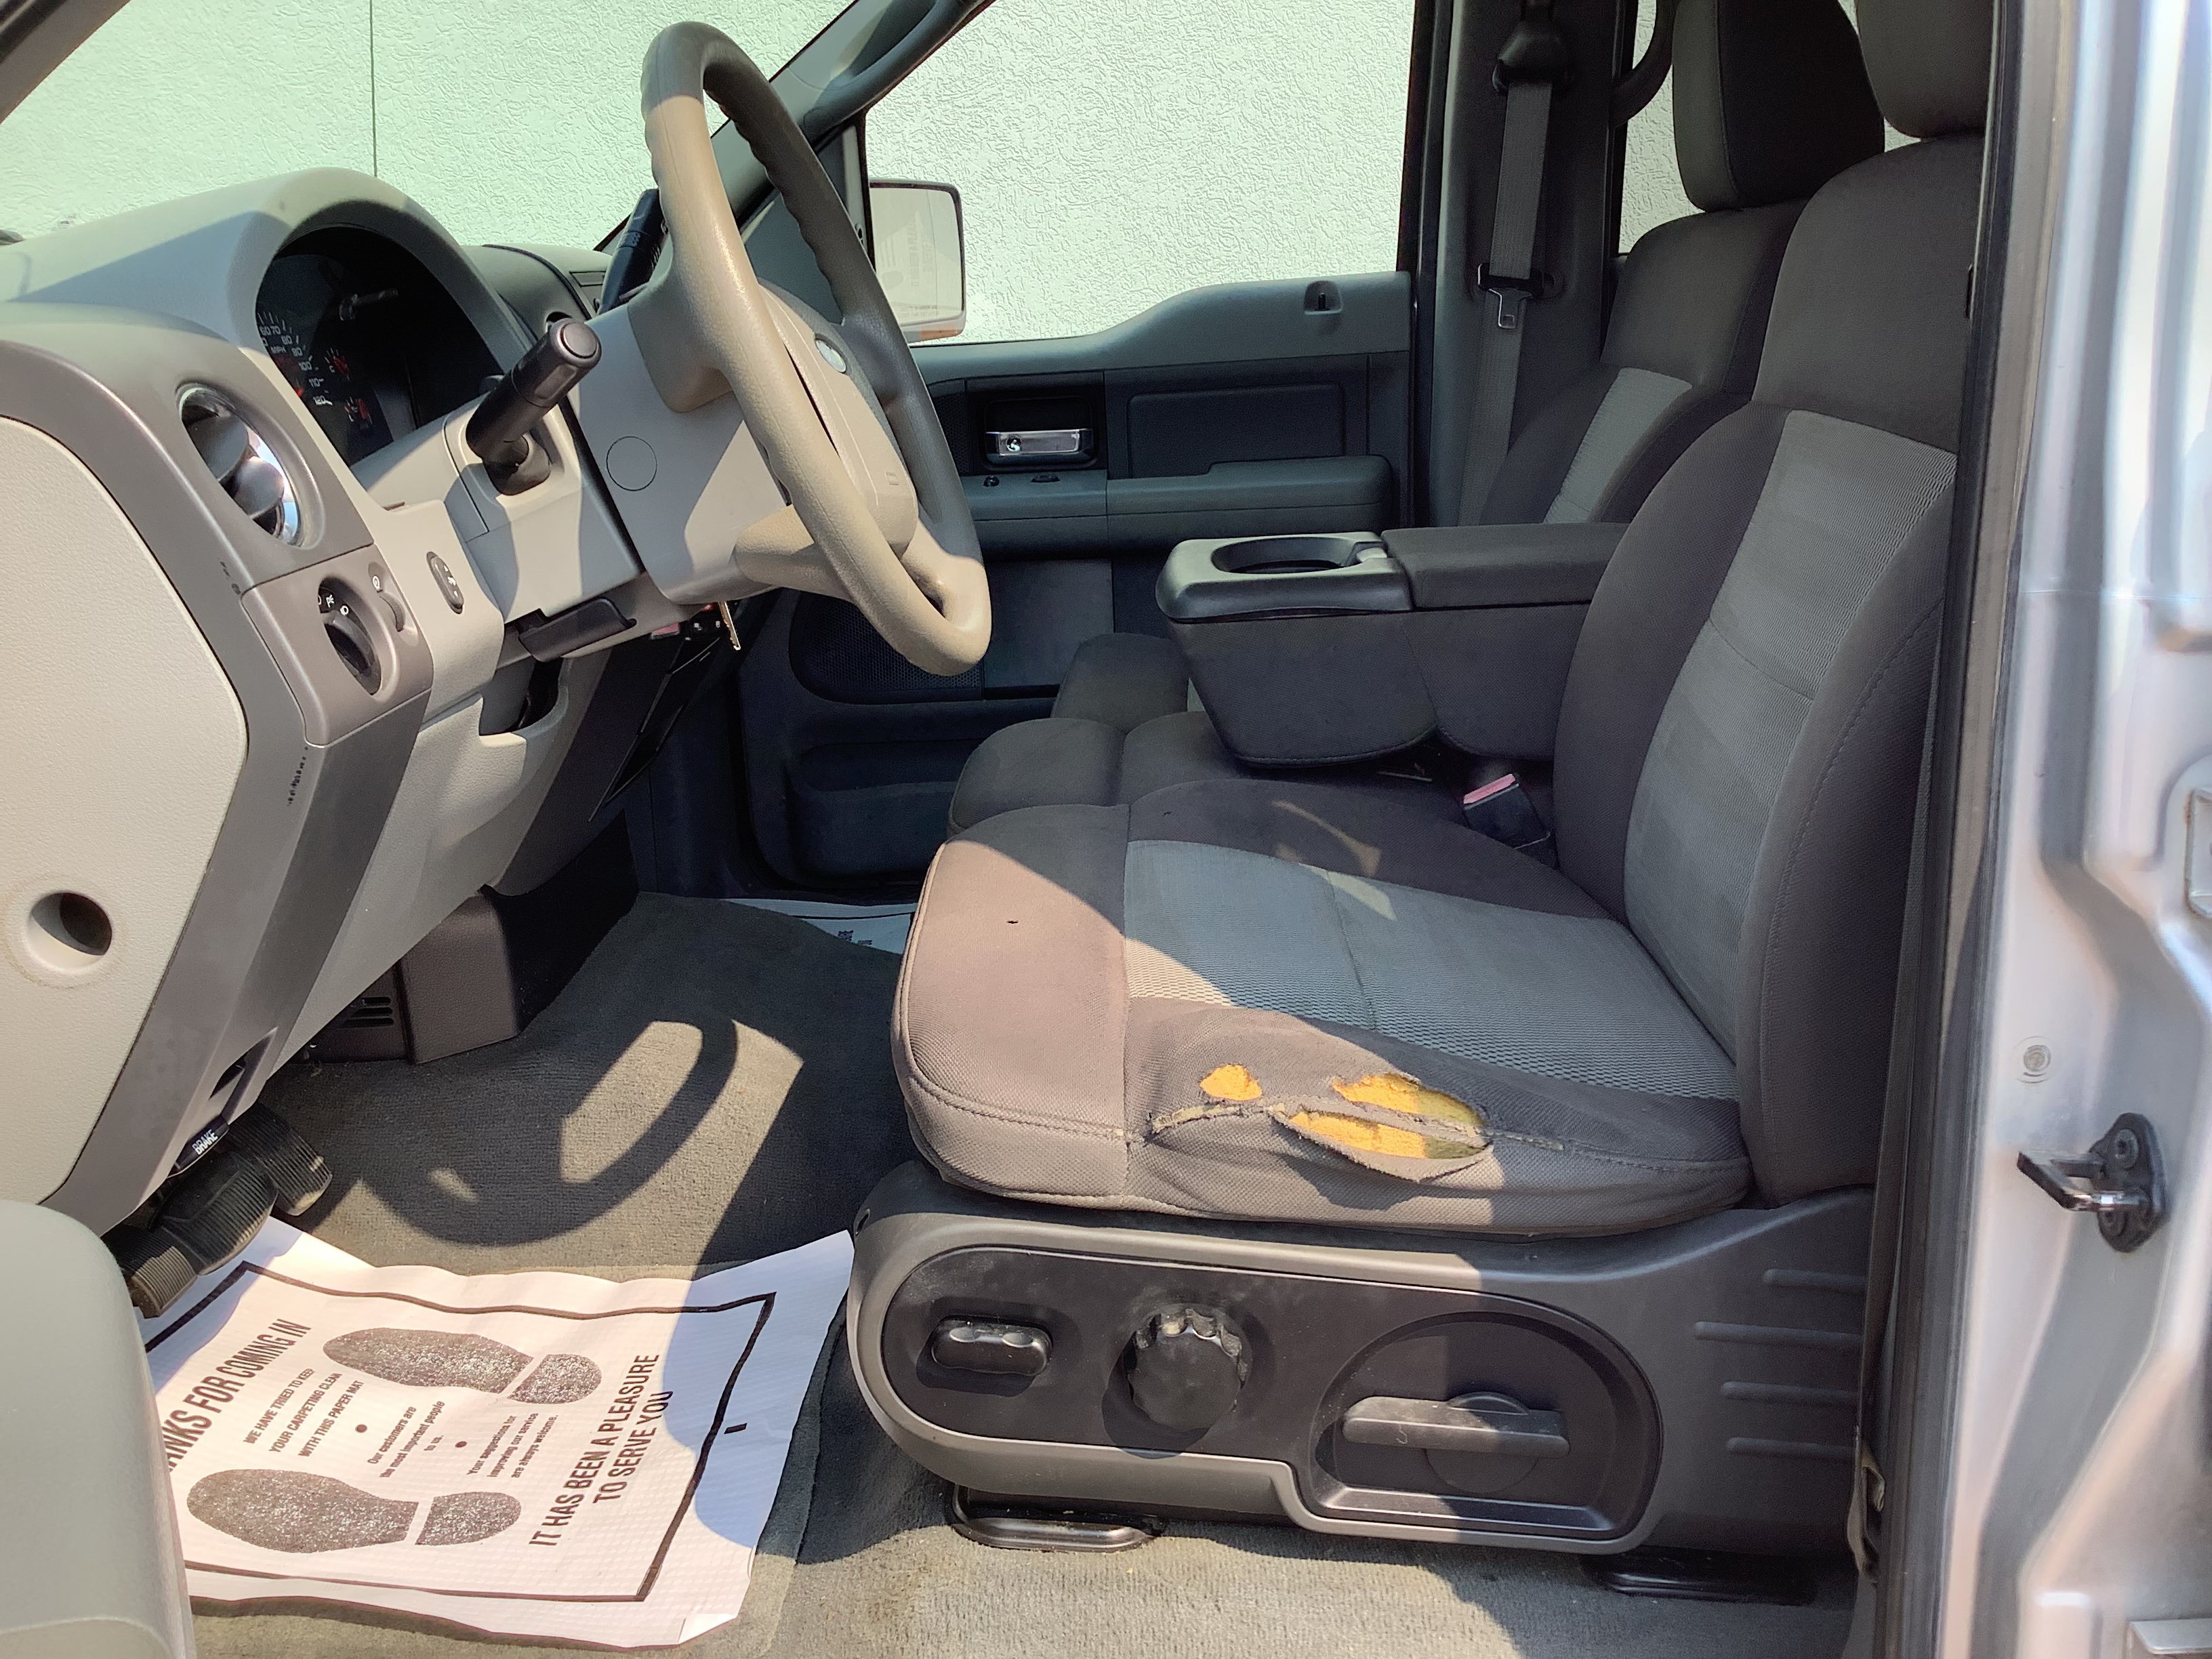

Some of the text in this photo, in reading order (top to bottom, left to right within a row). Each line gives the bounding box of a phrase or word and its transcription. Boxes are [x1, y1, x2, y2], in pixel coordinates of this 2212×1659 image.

[270, 325, 281, 335] 70
[299, 361, 312, 371] 100
[309, 378, 321, 387] 110
[192, 1129, 218, 1155] BRAKE
[182, 1376, 245, 1414] FOR
[216, 1334, 296, 1378] COMING
[268, 1319, 311, 1338] IN
[243, 1430, 262, 1444] WE
[254, 1410, 278, 1431] HAVE
[270, 1389, 295, 1409] TRIED
[288, 1380, 303, 1388] TO
[268, 1373, 342, 1452] YOUR CARPETING CLEAN
[298, 1380, 365, 1457] WITH THIS PAPER MAT
[367, 1406, 417, 1464] Our customers are
[390, 1452, 408, 1467] most
[400, 1424, 430, 1452] important
[424, 1401, 445, 1424] people
[466, 1460, 485, 1475] Your
[480, 1425, 511, 1459] suggestions
[487, 1413, 539, 1477] improving our service
[511, 1414, 558, 1478] are always welcome.
[529, 1354, 660, 1546] IT HAS BEEN A PLEASURE
[592, 1391, 674, 1503] TO SERVE YOU
